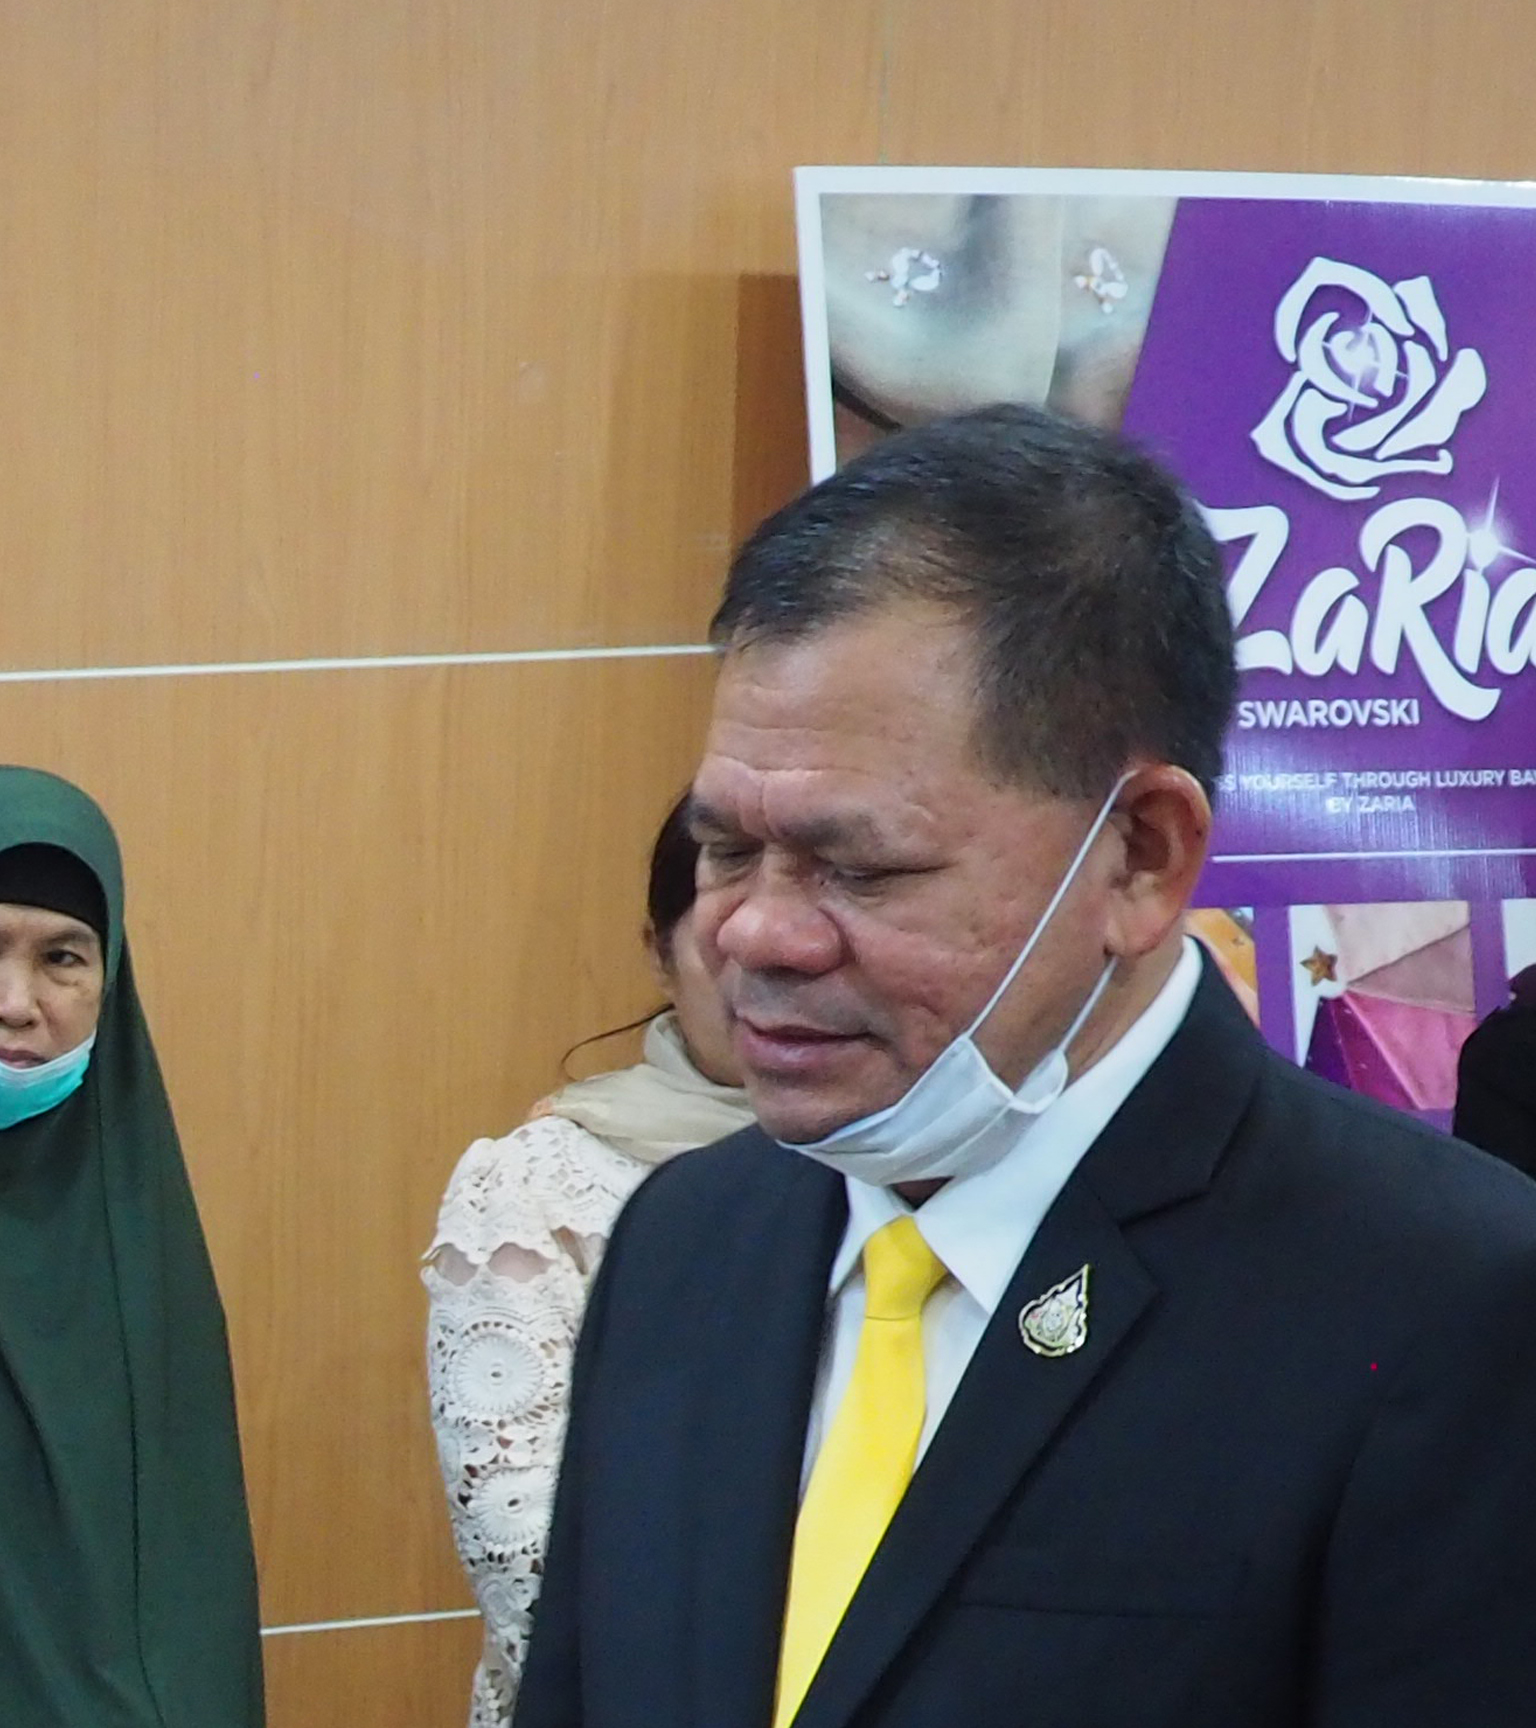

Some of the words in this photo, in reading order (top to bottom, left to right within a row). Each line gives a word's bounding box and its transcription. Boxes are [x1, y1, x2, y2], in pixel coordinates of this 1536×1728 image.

[1238, 698, 1420, 728] SWAROVSKI
[1241, 771, 1337, 791] YOURSELF
[1343, 771, 1429, 789] THROUGH
[1435, 769, 1504, 788] LUXURY
[1327, 797, 1353, 813] BY
[1359, 795, 1416, 813] ZARIA
